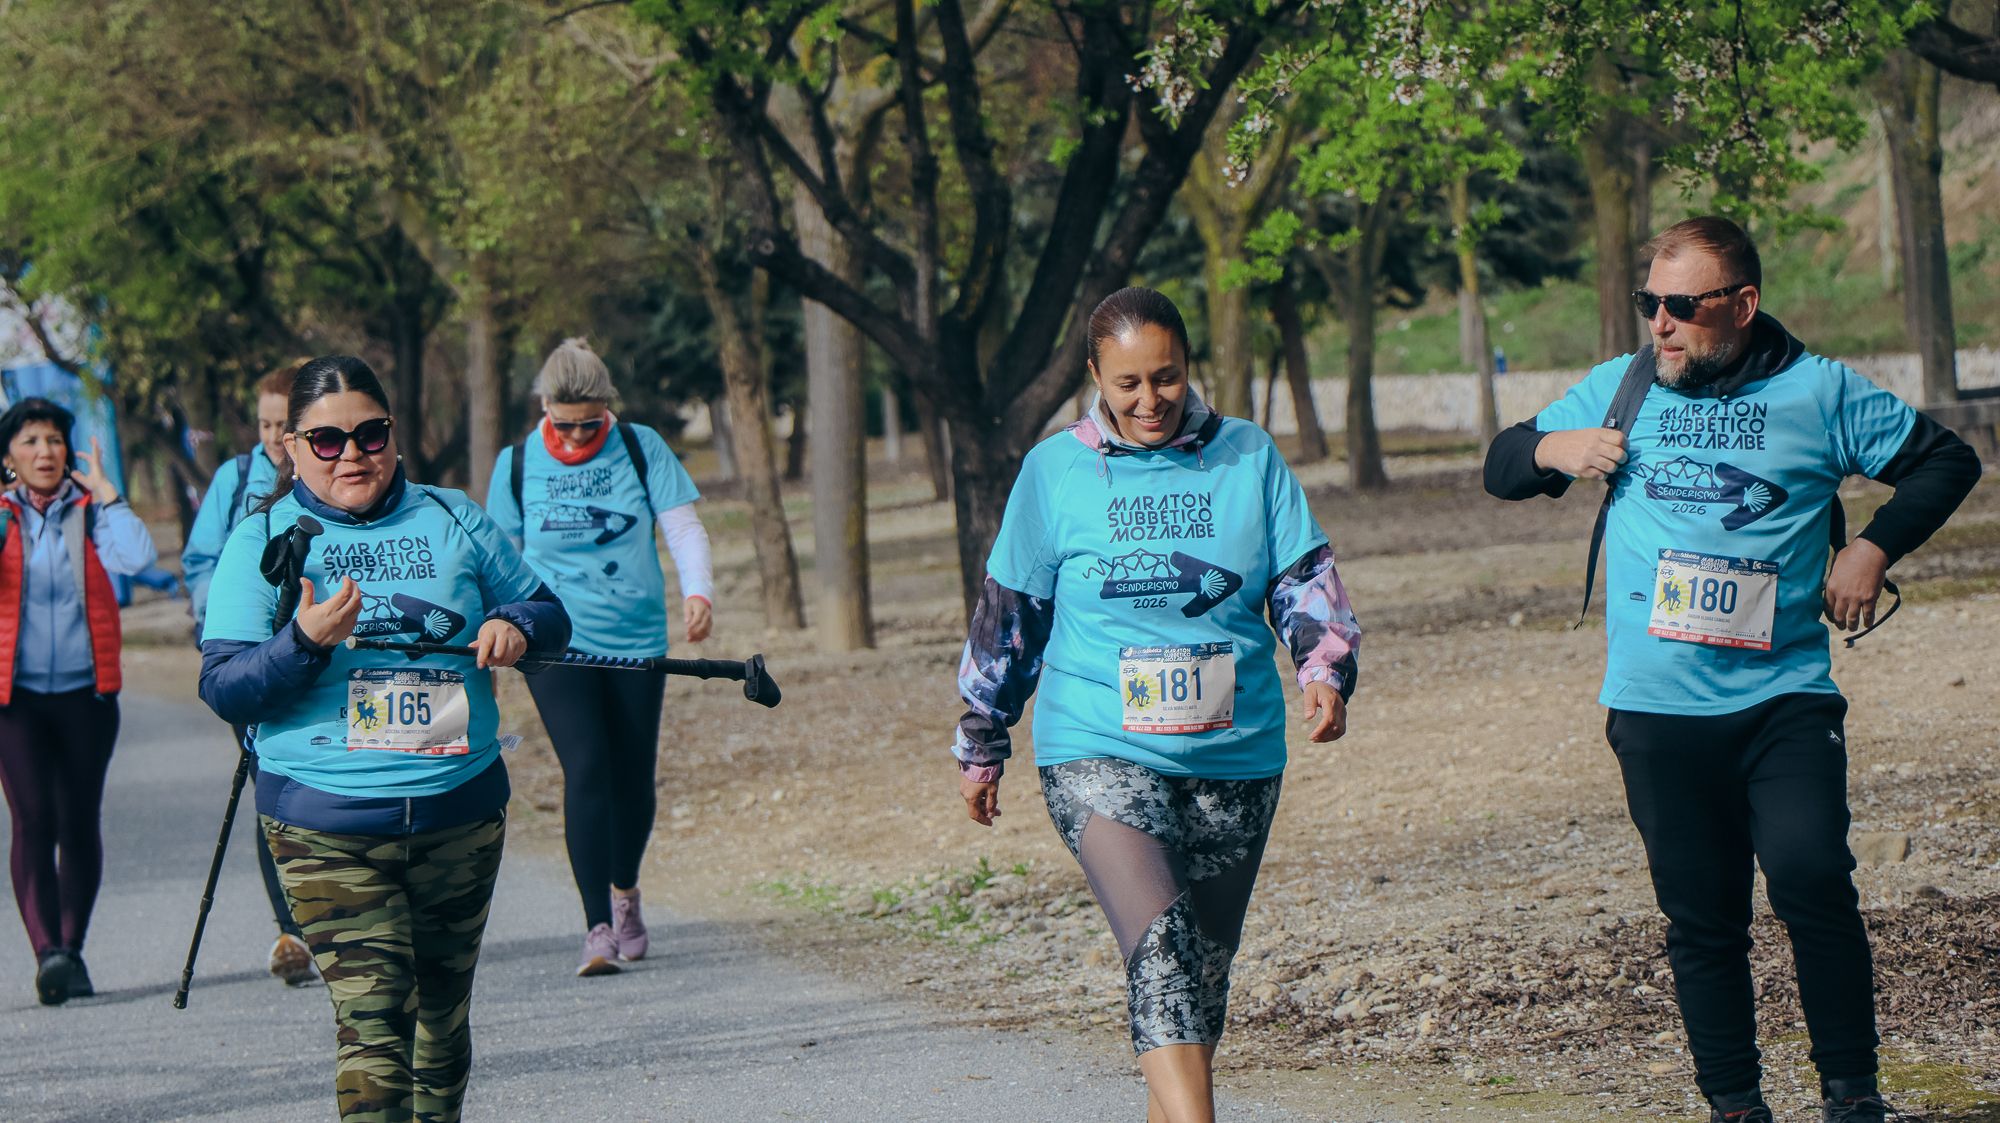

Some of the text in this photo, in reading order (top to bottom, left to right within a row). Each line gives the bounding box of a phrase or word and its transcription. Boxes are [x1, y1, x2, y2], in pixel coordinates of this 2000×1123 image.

[1659, 400, 1768, 420] MARATÓN
[1657, 415, 1765, 434] SUBBÉTICO
[1106, 490, 1212, 512] MARATÓN
[1656, 486, 1721, 500] SENDERISMO
[1107, 507, 1213, 528] SUBBÉTICO
[1671, 503, 1707, 515] 2026
[322, 535, 430, 557] MARATÓN
[323, 549, 433, 570] SUBBÉTICO
[1116, 580, 1179, 593] SENDERISMO
[1687, 575, 1738, 614] 180
[1132, 596, 1168, 609] 2026
[352, 620, 401, 634] NDERISMO
[1156, 666, 1202, 703] 181
[384, 691, 432, 726] 165
